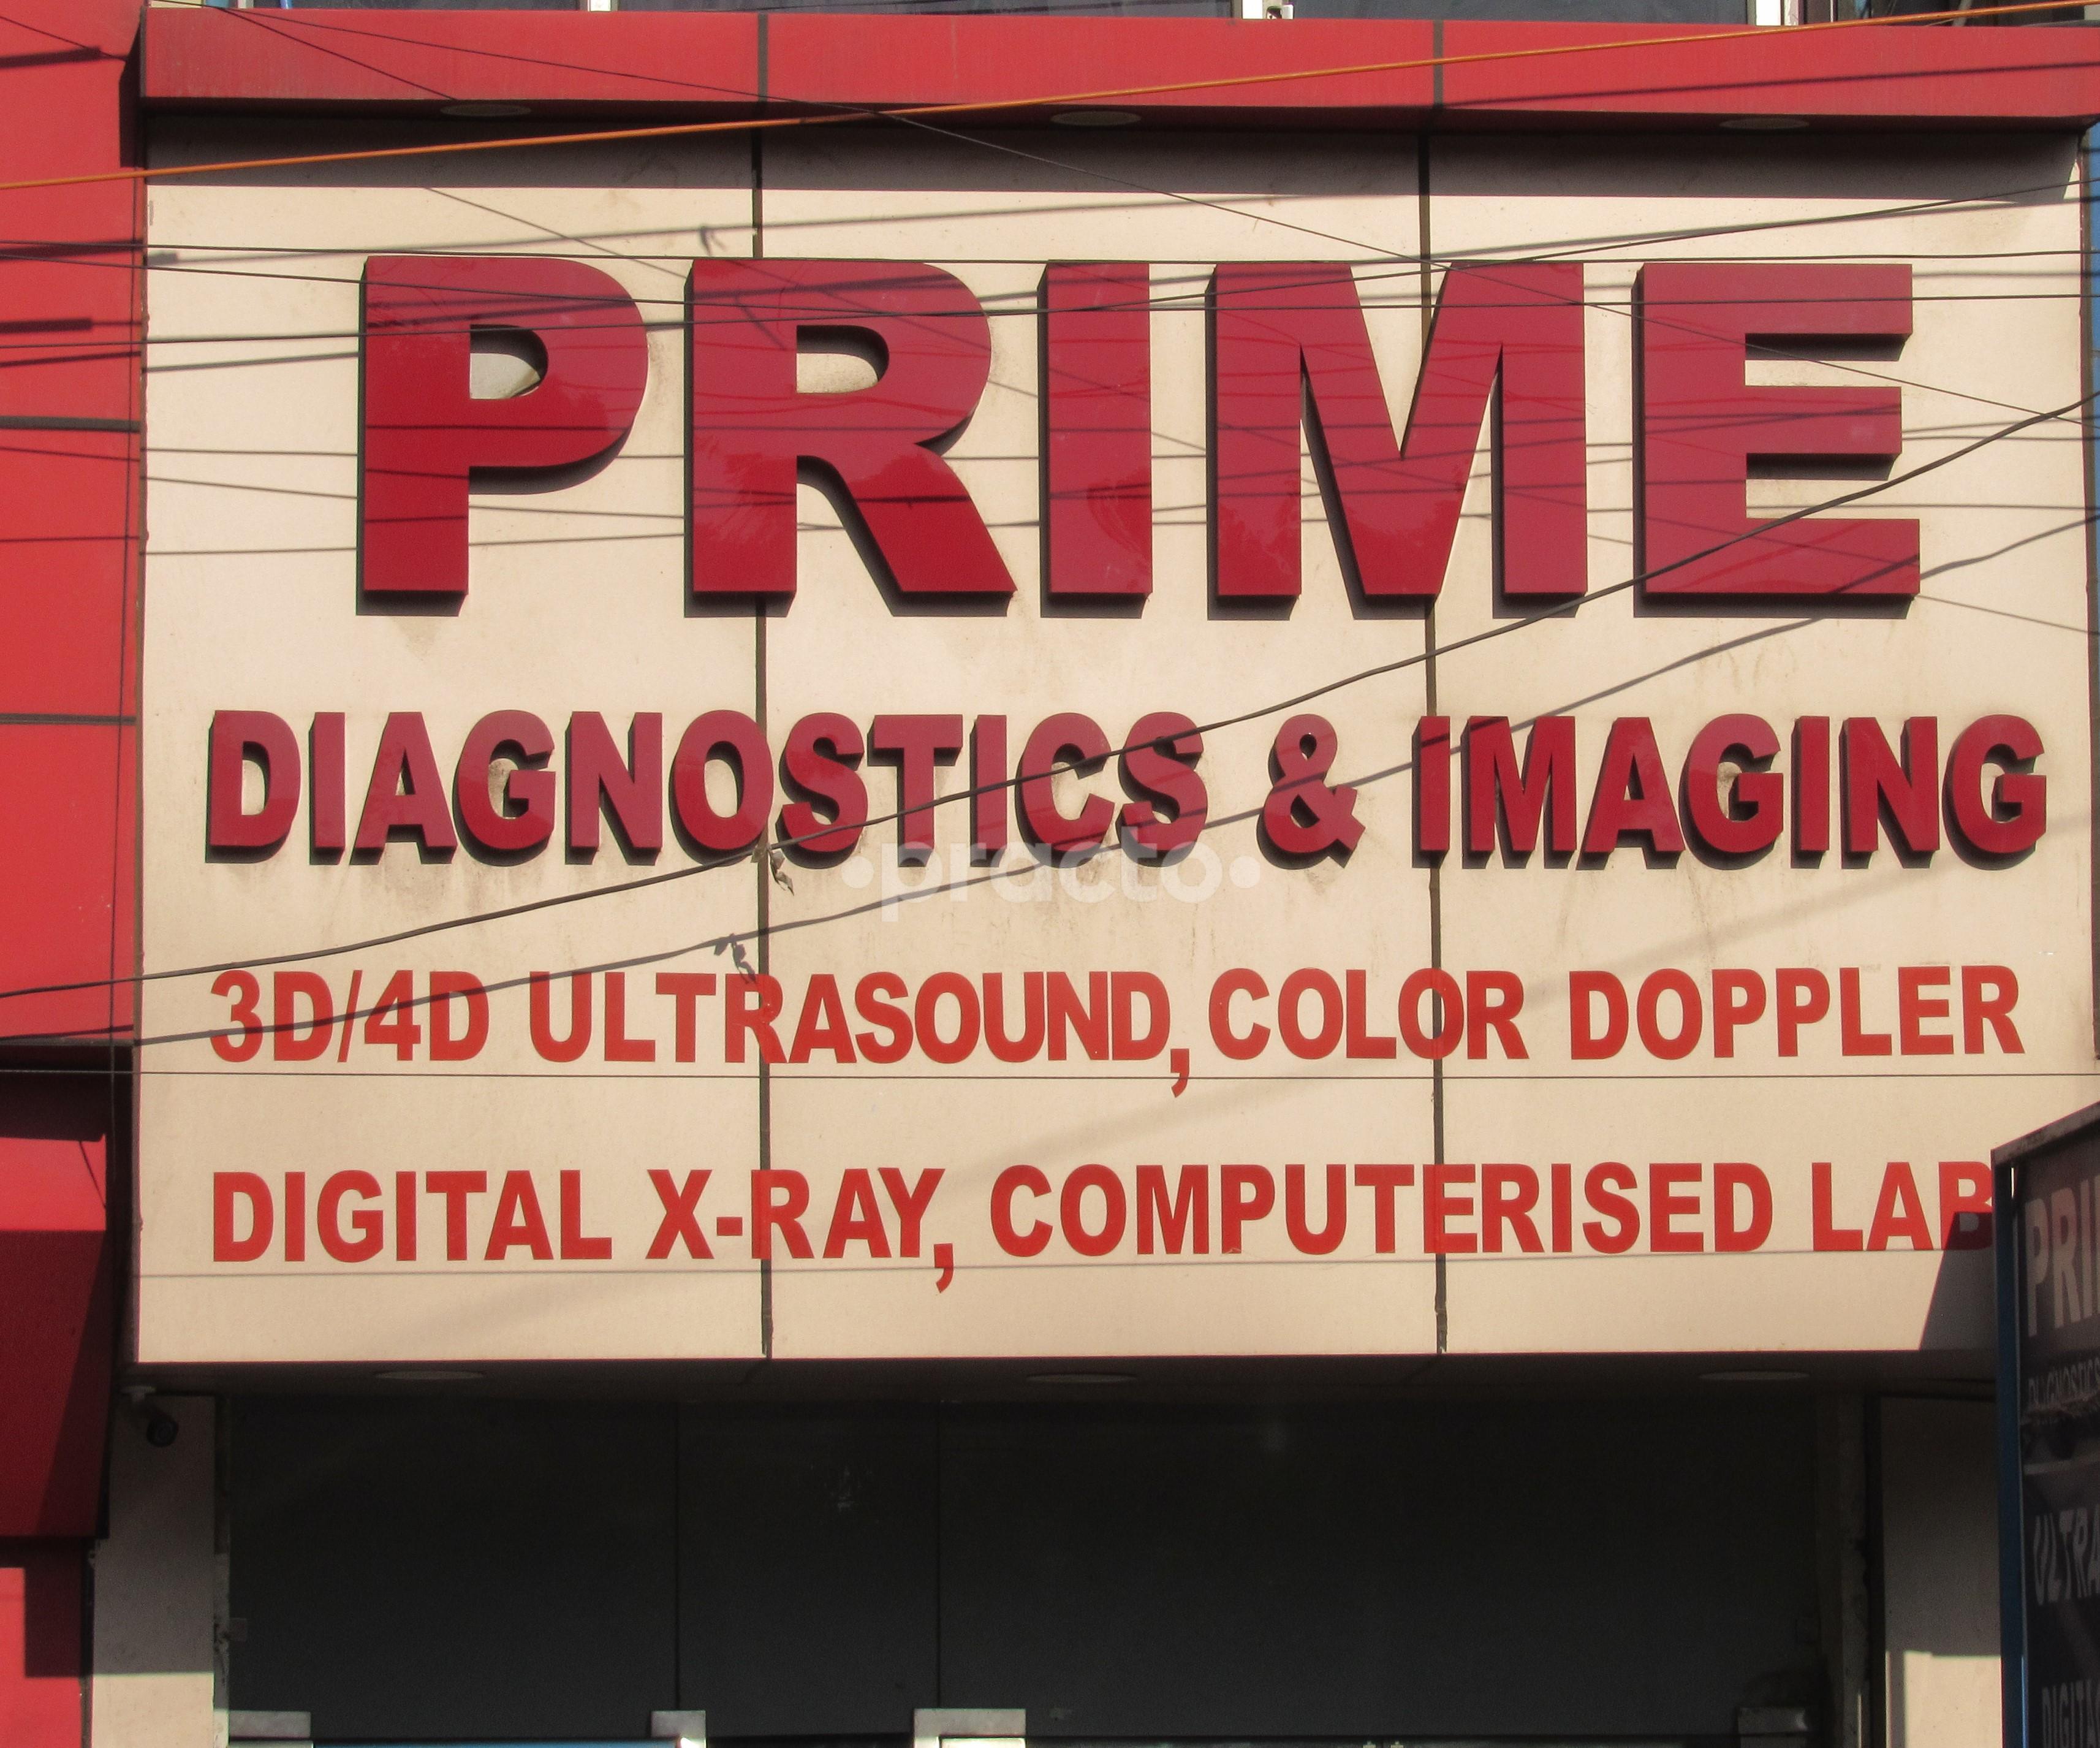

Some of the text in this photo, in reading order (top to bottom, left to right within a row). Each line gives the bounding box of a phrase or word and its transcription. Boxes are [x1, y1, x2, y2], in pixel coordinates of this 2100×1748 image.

[357, 256, 1920, 617] PRIME
[205, 710, 2047, 870] DIAGNOSTICS & IMAGING
[210, 965, 2025, 1098] 3D/4D ULTRASOUND, COLOR DOPPLER
[213, 1161, 1994, 1294] DIGITAL X-RAY, COMPUTERISED LAB
[2025, 1174, 2100, 1337] PRI
